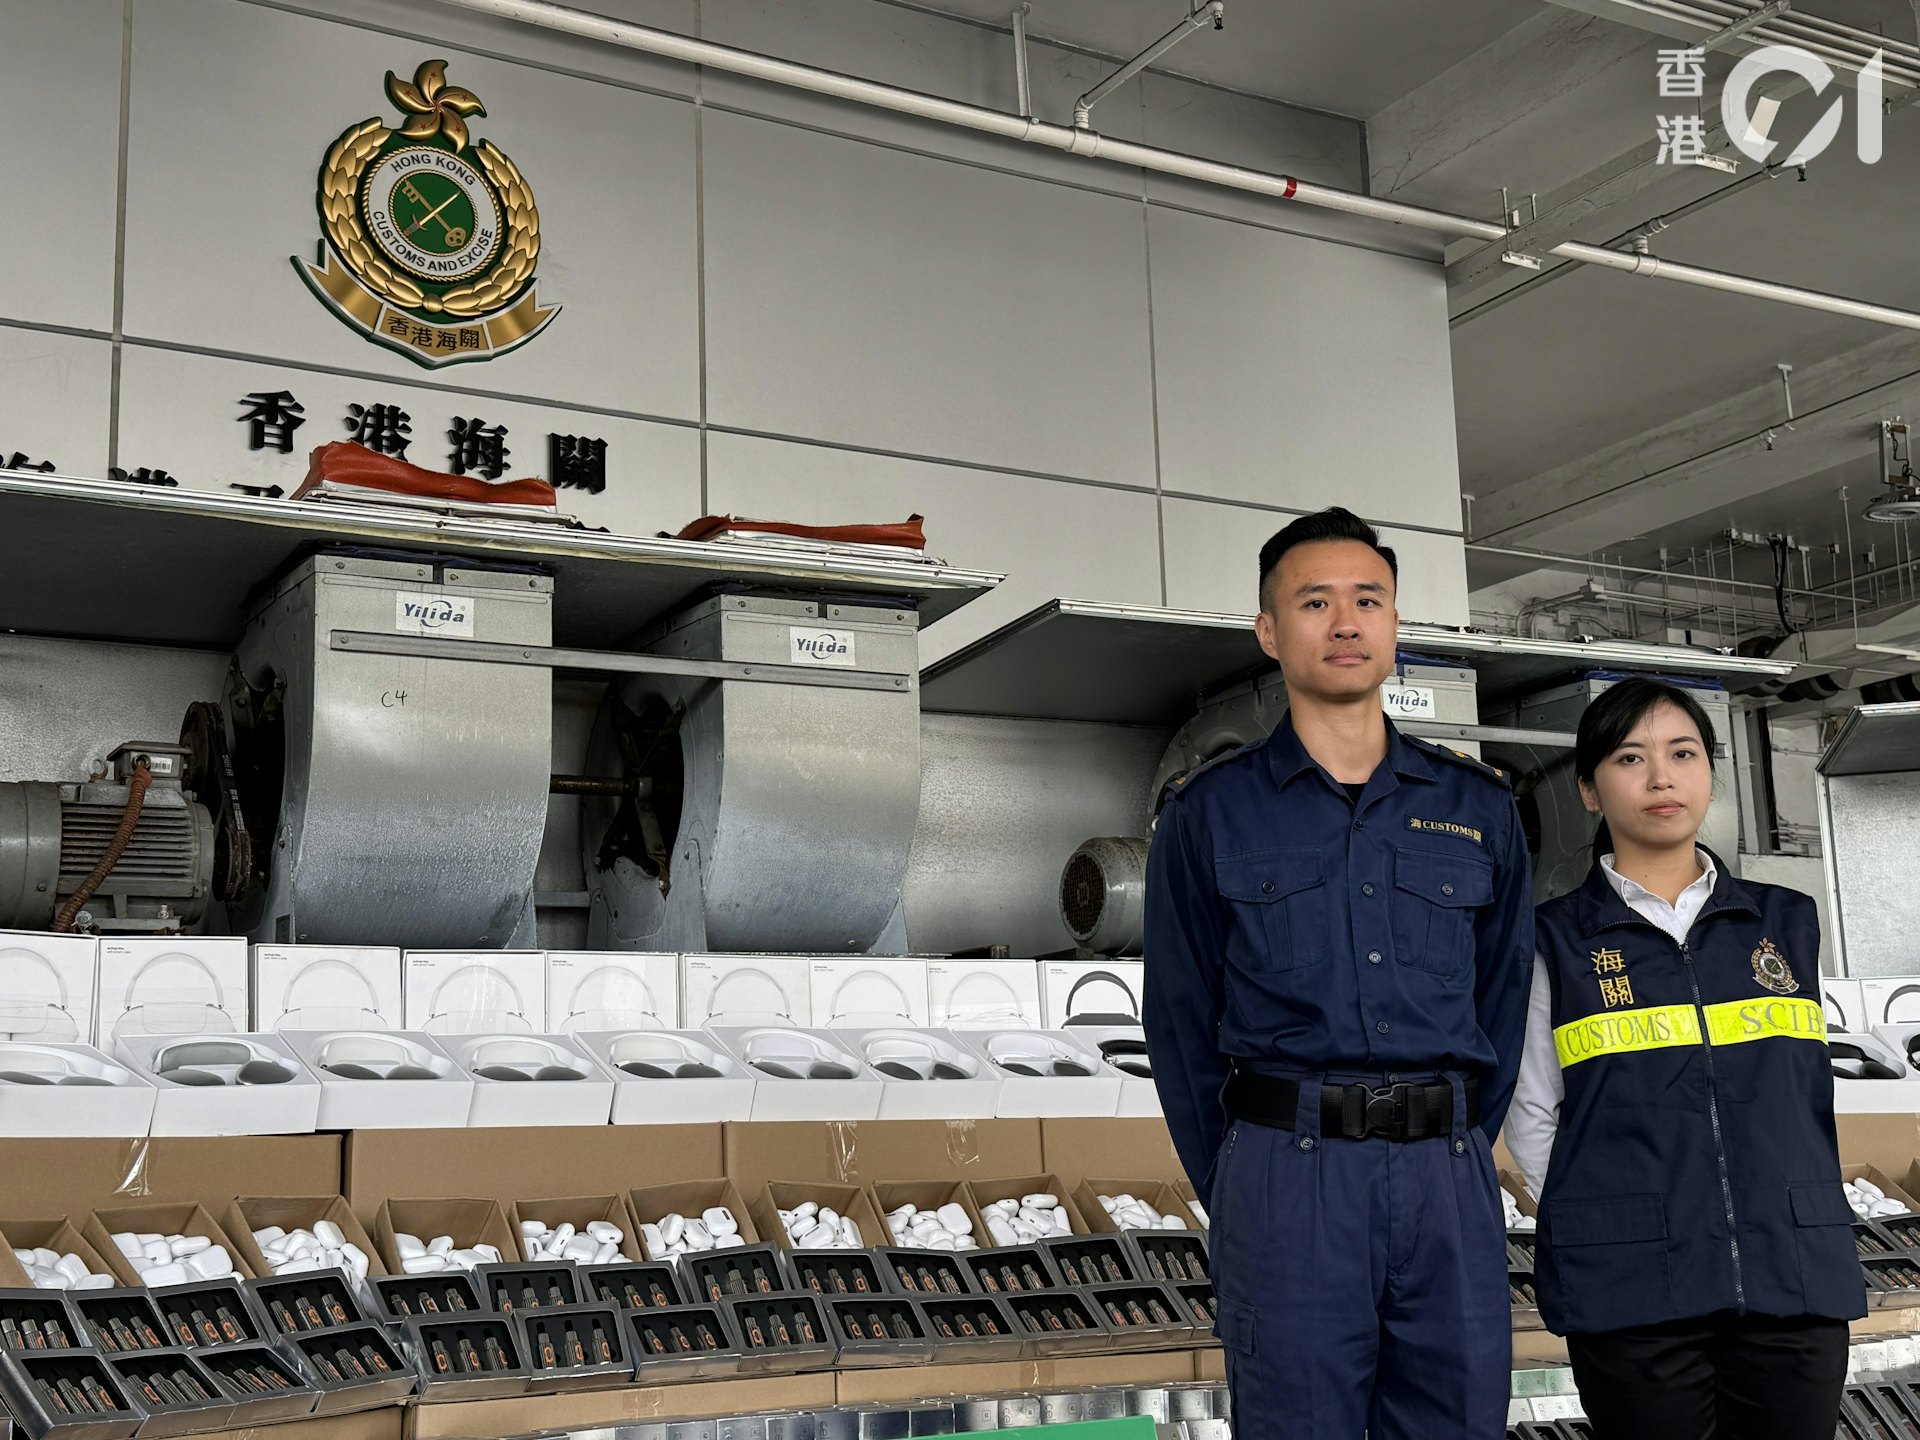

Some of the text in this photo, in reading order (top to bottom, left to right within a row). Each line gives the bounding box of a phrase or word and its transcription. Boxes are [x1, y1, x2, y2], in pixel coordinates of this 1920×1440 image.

[390, 153, 476, 186] HONG KONG
[372, 210, 493, 271] CUSTOMS AND EXCISE
[387, 316, 480, 350] 香港海關
[237, 390, 609, 493] 香港海關
[404, 603, 465, 623] Yilida
[796, 638, 848, 654] Yilida
[381, 690, 408, 708] C4
[1388, 693, 1428, 707] Yilida
[1422, 820, 1474, 837] CUSTOMS
[1591, 947, 1634, 1009] 海關
[1565, 1012, 1671, 1058] CUSTOMS
[1739, 1002, 1823, 1035] SCIB
